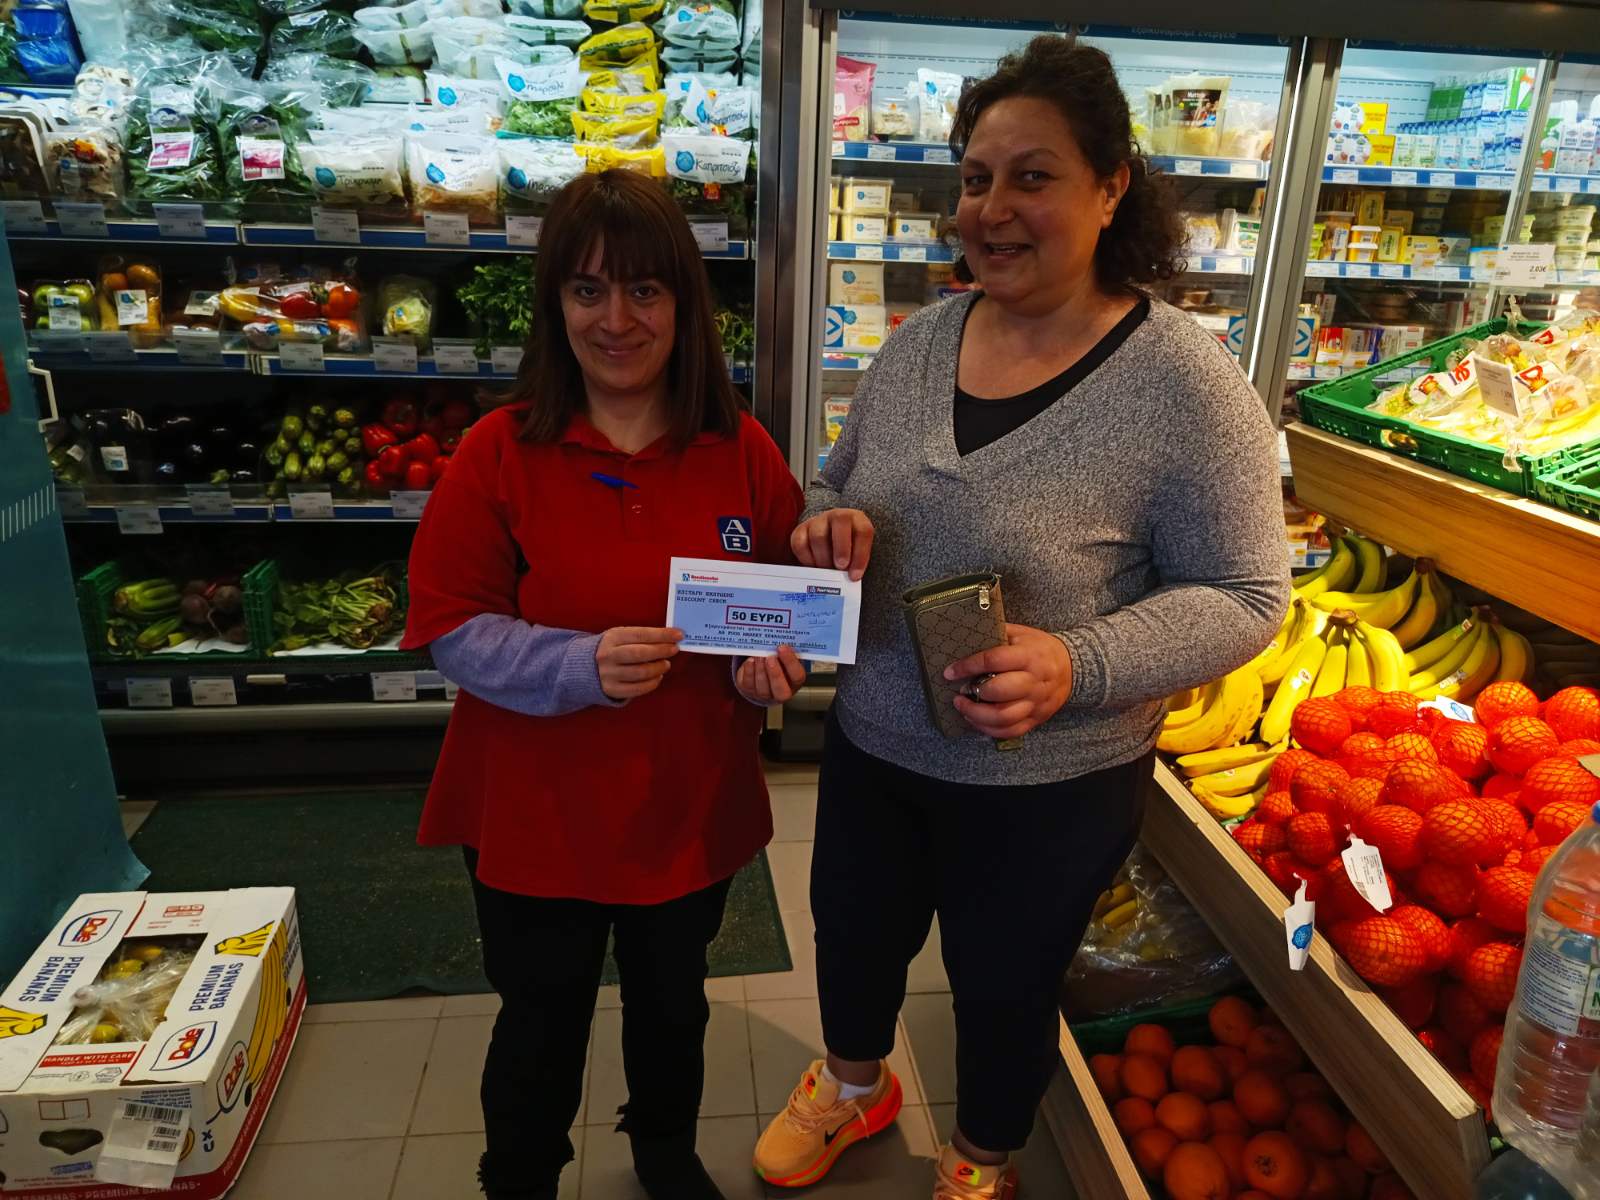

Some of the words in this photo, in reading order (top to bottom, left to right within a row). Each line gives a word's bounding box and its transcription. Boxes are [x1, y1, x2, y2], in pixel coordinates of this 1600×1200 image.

[731, 610, 747, 621] 50
[750, 613, 784, 624] ΕΥΡΩ
[71, 917, 107, 944] Dole
[18, 956, 65, 1003] BANANAS
[38, 955, 85, 1003] PREMIUM
[188, 963, 226, 1012] PREMIUM
[208, 962, 244, 1011] BANANAS
[83, 1053, 110, 1061] WITH
[168, 1027, 205, 1062] Dole
